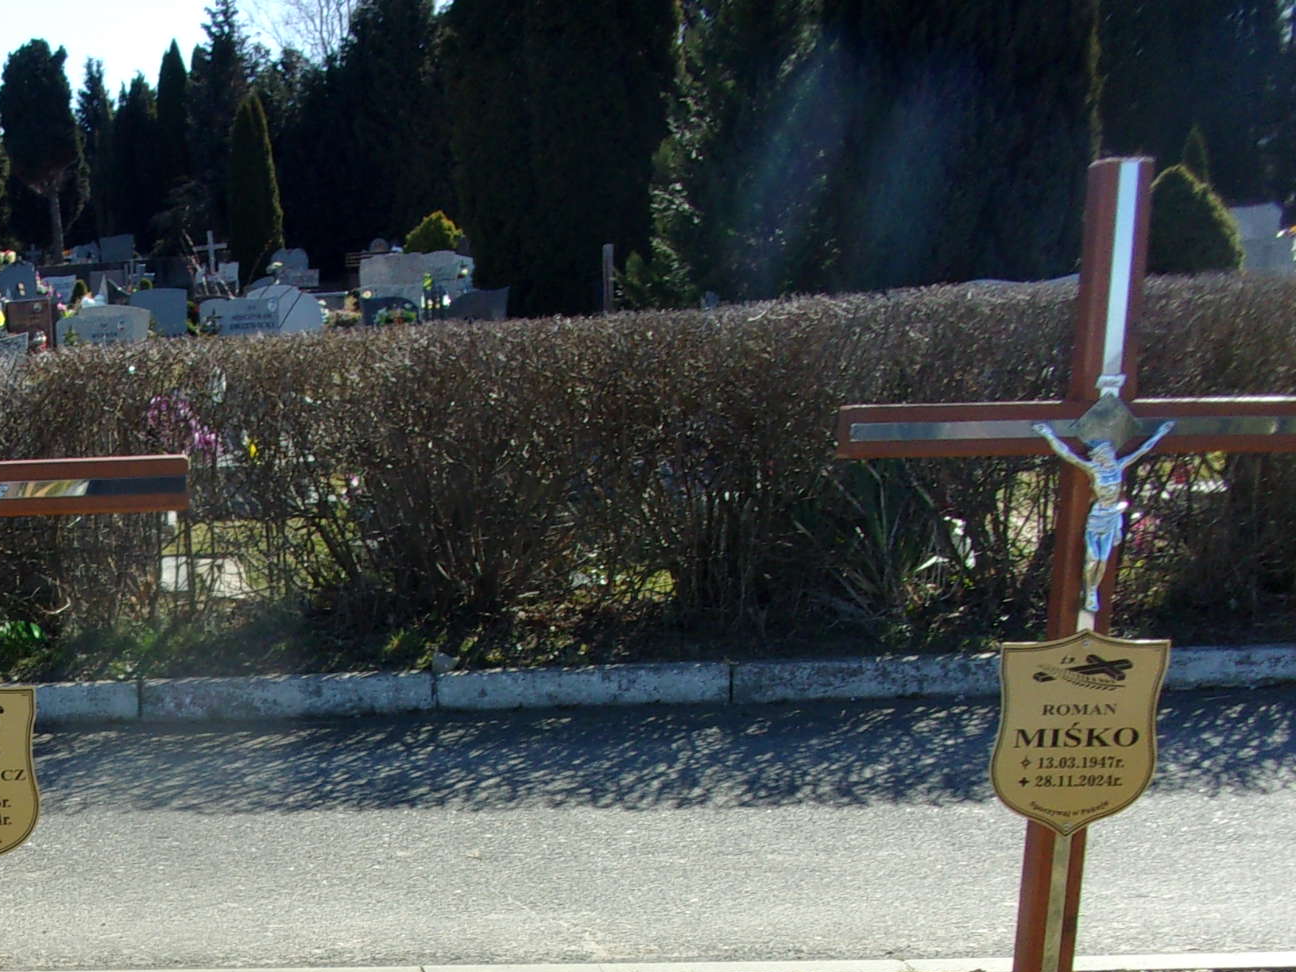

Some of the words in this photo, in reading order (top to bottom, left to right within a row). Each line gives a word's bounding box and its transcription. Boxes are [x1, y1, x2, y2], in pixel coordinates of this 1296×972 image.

[1041, 703, 1117, 716] ROMAN
[1013, 722, 1140, 749] MIŚKO
[1036, 756, 1125, 769] 13.03.1947r.
[1034, 775, 1123, 787] 28.11.2024r.
